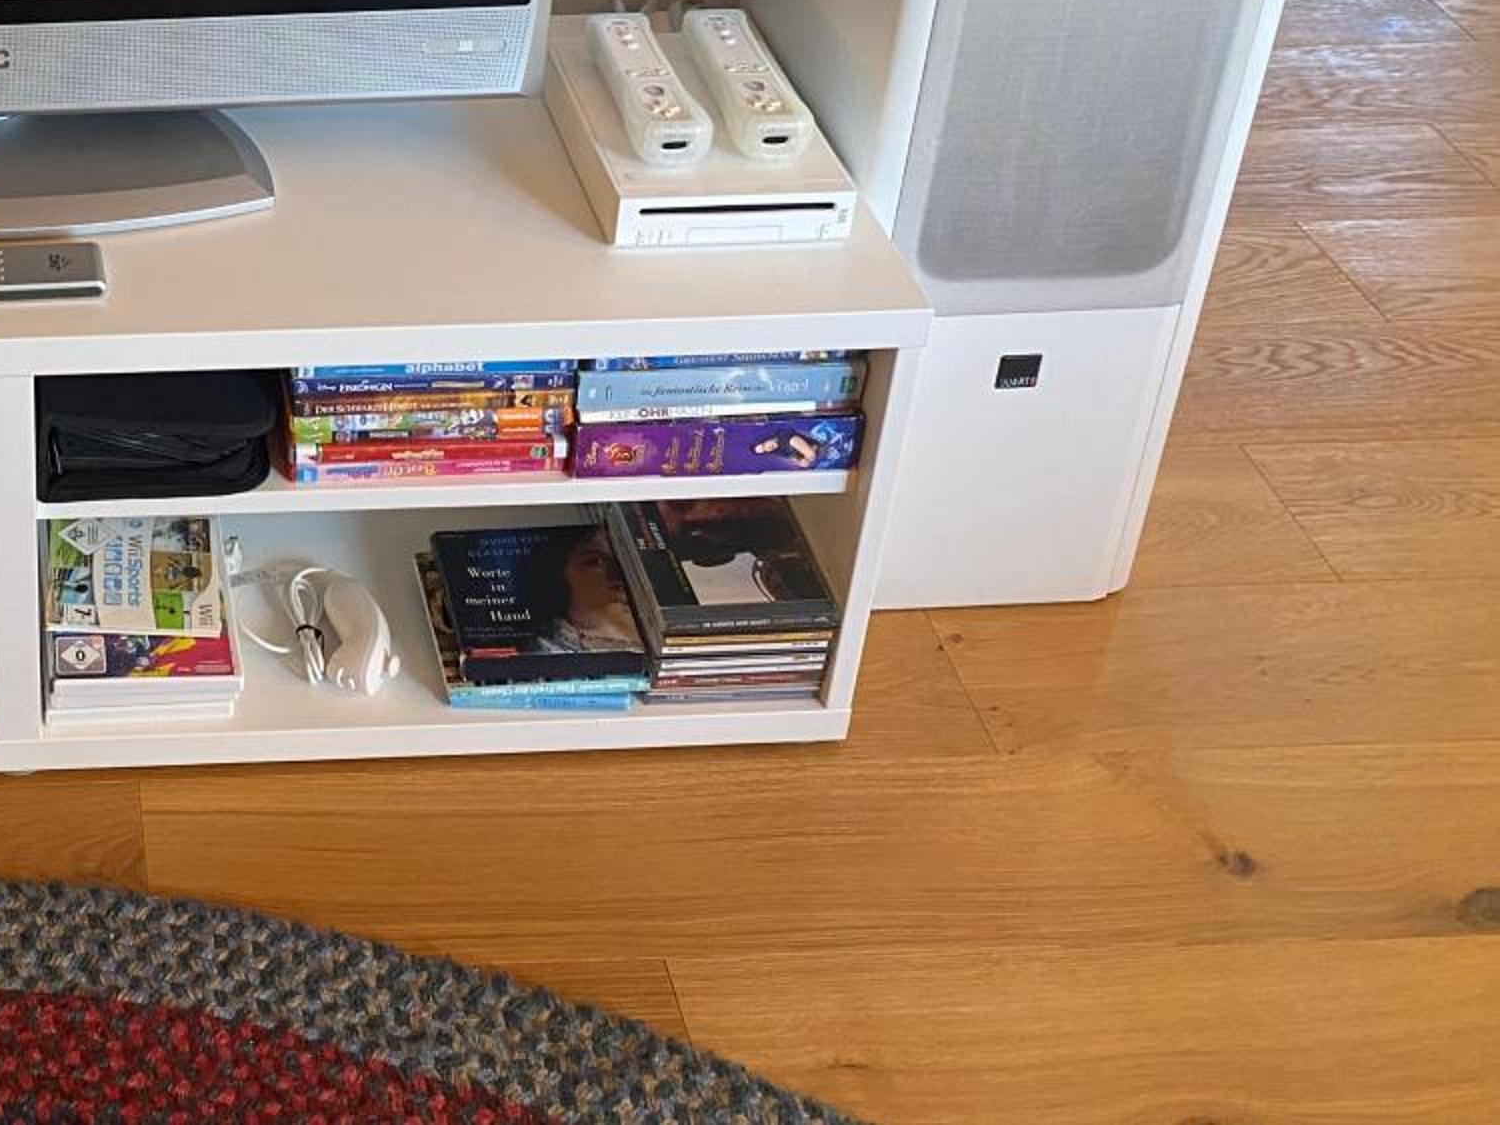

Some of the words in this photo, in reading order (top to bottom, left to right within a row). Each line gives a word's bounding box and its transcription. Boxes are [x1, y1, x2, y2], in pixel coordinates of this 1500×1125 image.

[404, 361, 485, 375] alphabet
[466, 566, 513, 579] Worte
[490, 583, 507, 592] in
[464, 594, 518, 606] meiner
[489, 608, 532, 623] Hand
